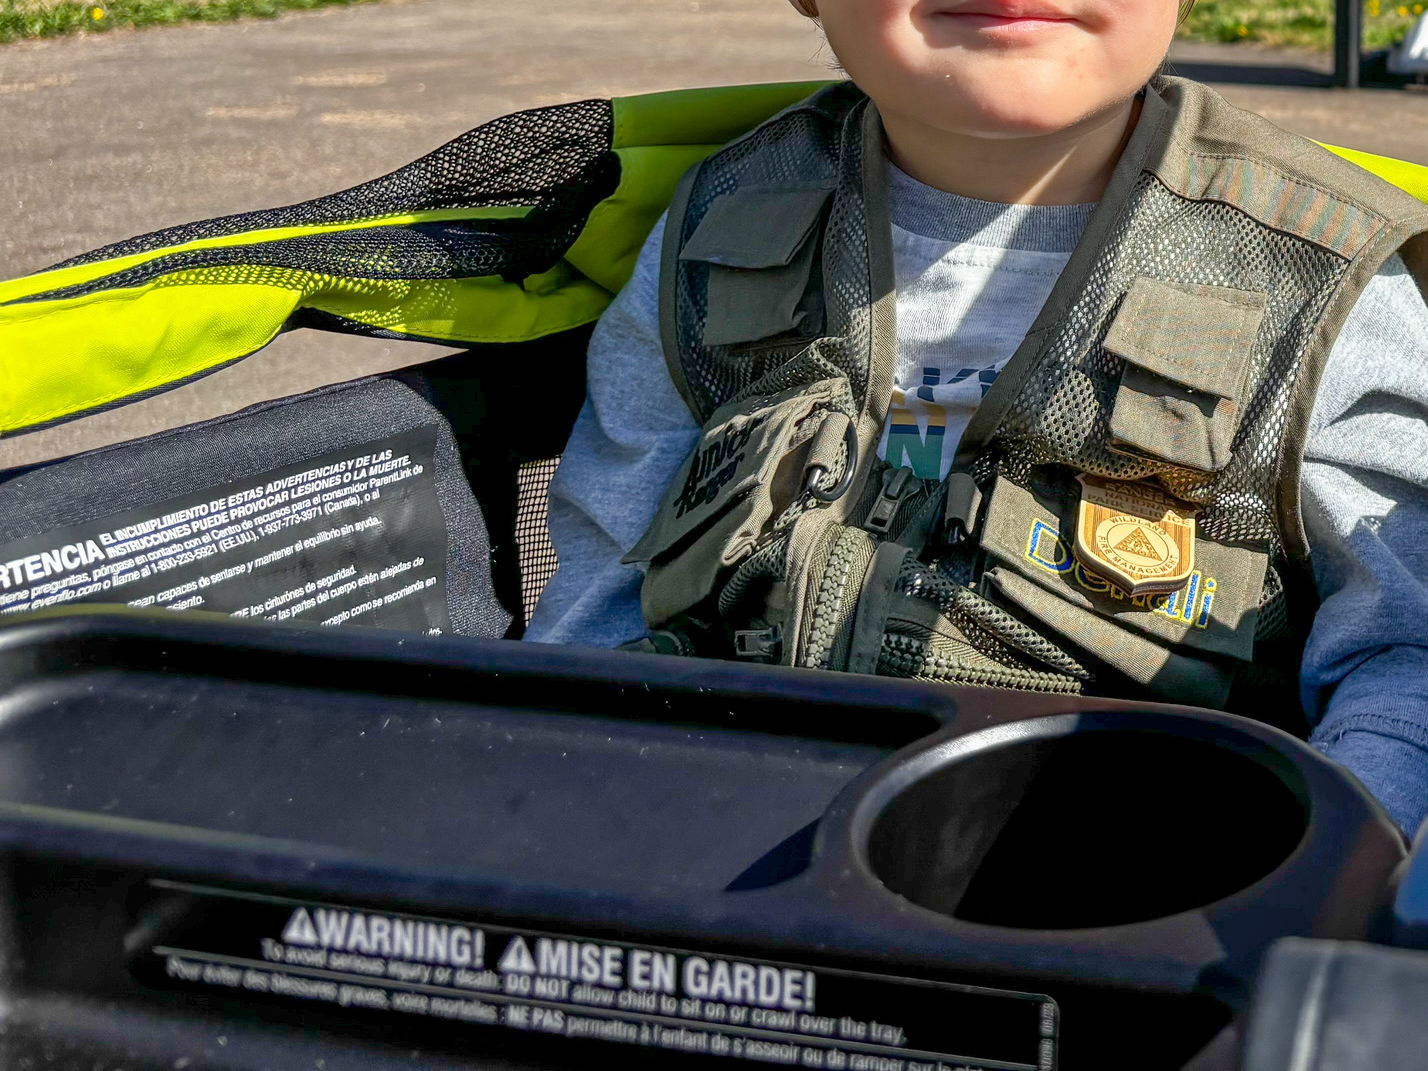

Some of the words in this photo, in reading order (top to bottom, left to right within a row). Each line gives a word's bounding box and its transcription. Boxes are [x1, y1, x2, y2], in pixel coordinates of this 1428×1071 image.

[30, 572, 92, 600] preguntas,
[92, 557, 136, 581] póngase
[134, 554, 148, 566] en
[183, 537, 202, 549] con
[201, 532, 212, 543] el
[210, 523, 242, 540] Centro
[241, 519, 253, 530] de
[253, 505, 291, 526] recursos
[291, 499, 312, 516] para
[312, 494, 321, 505] el
[322, 481, 369, 502] consumidor
[413, 464, 424, 475] de
[99, 533, 117, 545] EL
[114, 504, 208, 541] INCUMPLIMIENTO
[210, 499, 226, 512] DE
[227, 486, 264, 507] ESTAS
[265, 461, 346, 495] ADVERTENCIAS
[345, 459, 355, 470] Y
[355, 455, 371, 468] DE
[372, 449, 393, 464] LAS
[104, 524, 192, 558] INSTRUCCIONES
[190, 511, 229, 533] PUEDE
[229, 490, 289, 520] PROVOCAR
[290, 472, 342, 499] LESIONES
[342, 472, 352, 483] O
[353, 468, 367, 481] LA
[368, 455, 411, 476] MUERTE.
[1109, 517, 1167, 536] WILDLAND
[102, 579, 112, 590] o
[112, 569, 140, 587] llame
[140, 564, 152, 578] al
[364, 493, 371, 502] o
[372, 489, 381, 500] al
[156, 581, 198, 602] capaces
[198, 576, 211, 588] de
[211, 563, 246, 583] sentarse
[246, 560, 254, 573] y
[254, 545, 295, 568] mantener
[295, 540, 304, 552] el
[303, 527, 341, 550] equilibrio
[340, 524, 354, 535] sin
[1112, 554, 1178, 575] MANAGEMENT
[250, 604, 264, 617] los
[305, 581, 316, 593] de
[278, 609, 291, 621] las
[291, 597, 316, 616] partes
[316, 590, 330, 604] del
[329, 579, 357, 598] cuerpo
[412, 556, 425, 568] de
[351, 601, 373, 617] como
[372, 597, 383, 609] se
[383, 581, 425, 604] recomienda
[425, 575, 437, 587] en
[313, 908, 486, 969] WARNING!
[537, 937, 624, 989] MISE
[628, 949, 676, 994] EN
[682, 955, 816, 1013] GARDE!
